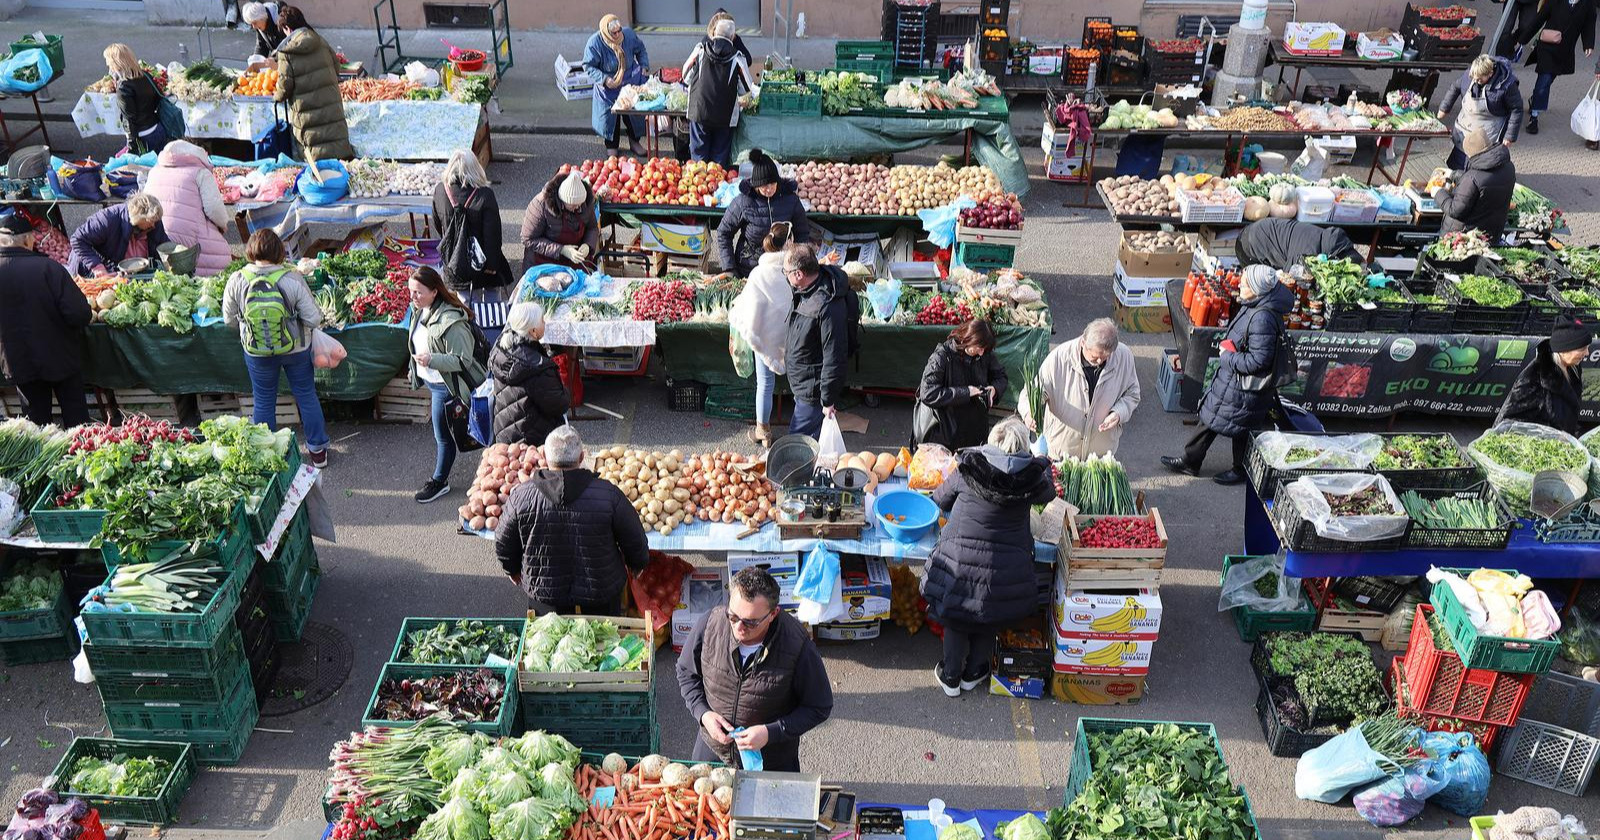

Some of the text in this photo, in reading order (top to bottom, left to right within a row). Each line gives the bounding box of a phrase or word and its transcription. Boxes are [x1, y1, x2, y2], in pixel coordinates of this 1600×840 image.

[1298, 336, 1381, 346] proizvod
[1327, 346, 1379, 354] proizvodnja
[1384, 377, 1429, 396] EKO
[1316, 402, 1340, 411] 10382
[1341, 404, 1366, 415] Donja
[1413, 398, 1429, 407] 097
[1447, 402, 1464, 412] 222,
[1465, 405, 1494, 413] e-mail:
[1074, 613, 1091, 621] Dole
[1057, 678, 1101, 686] BANANAS
[1010, 685, 1024, 693] SUN
